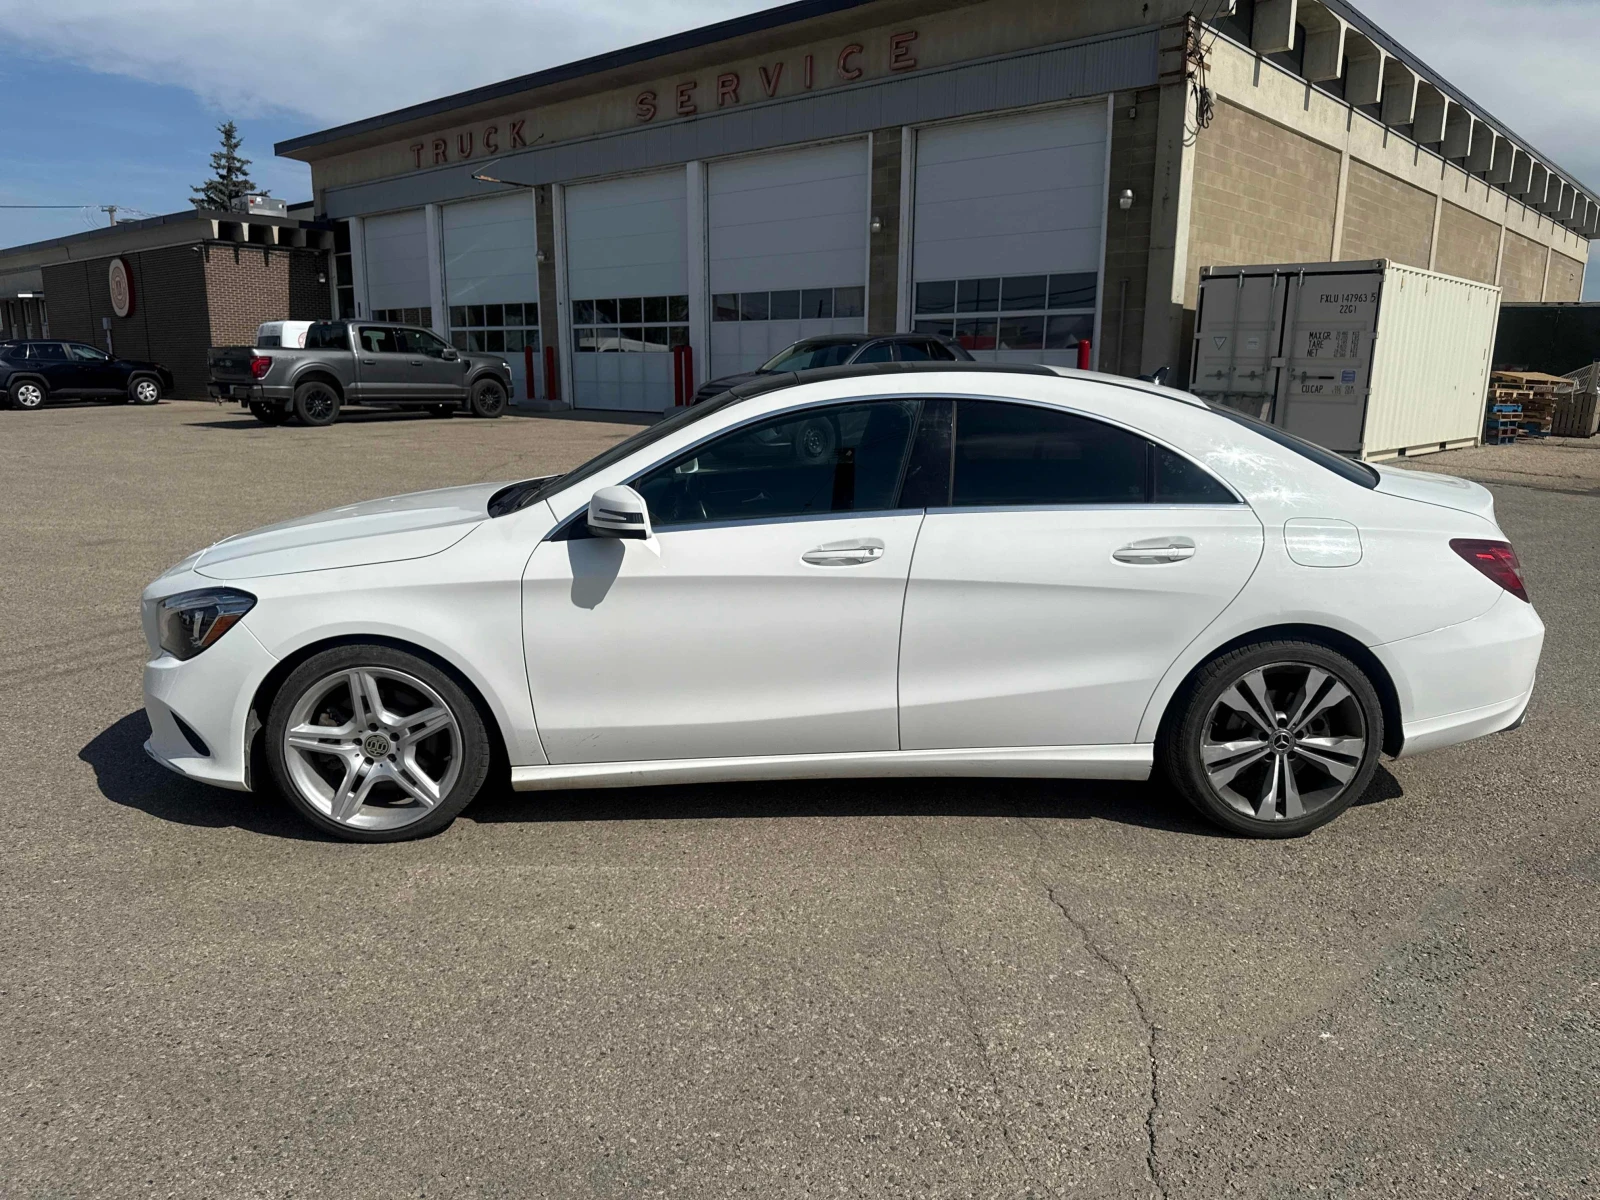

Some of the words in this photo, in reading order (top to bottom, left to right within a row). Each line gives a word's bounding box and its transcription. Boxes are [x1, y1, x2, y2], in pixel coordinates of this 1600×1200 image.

[410, 119, 527, 169] TRUCK
[636, 30, 918, 121] SERVICE
[1320, 294, 1339, 303] FXLU
[1341, 293, 1367, 303] 147963
[1370, 292, 1377, 303] 5
[1308, 340, 1324, 349] TARE
[1307, 349, 1319, 357] NET
